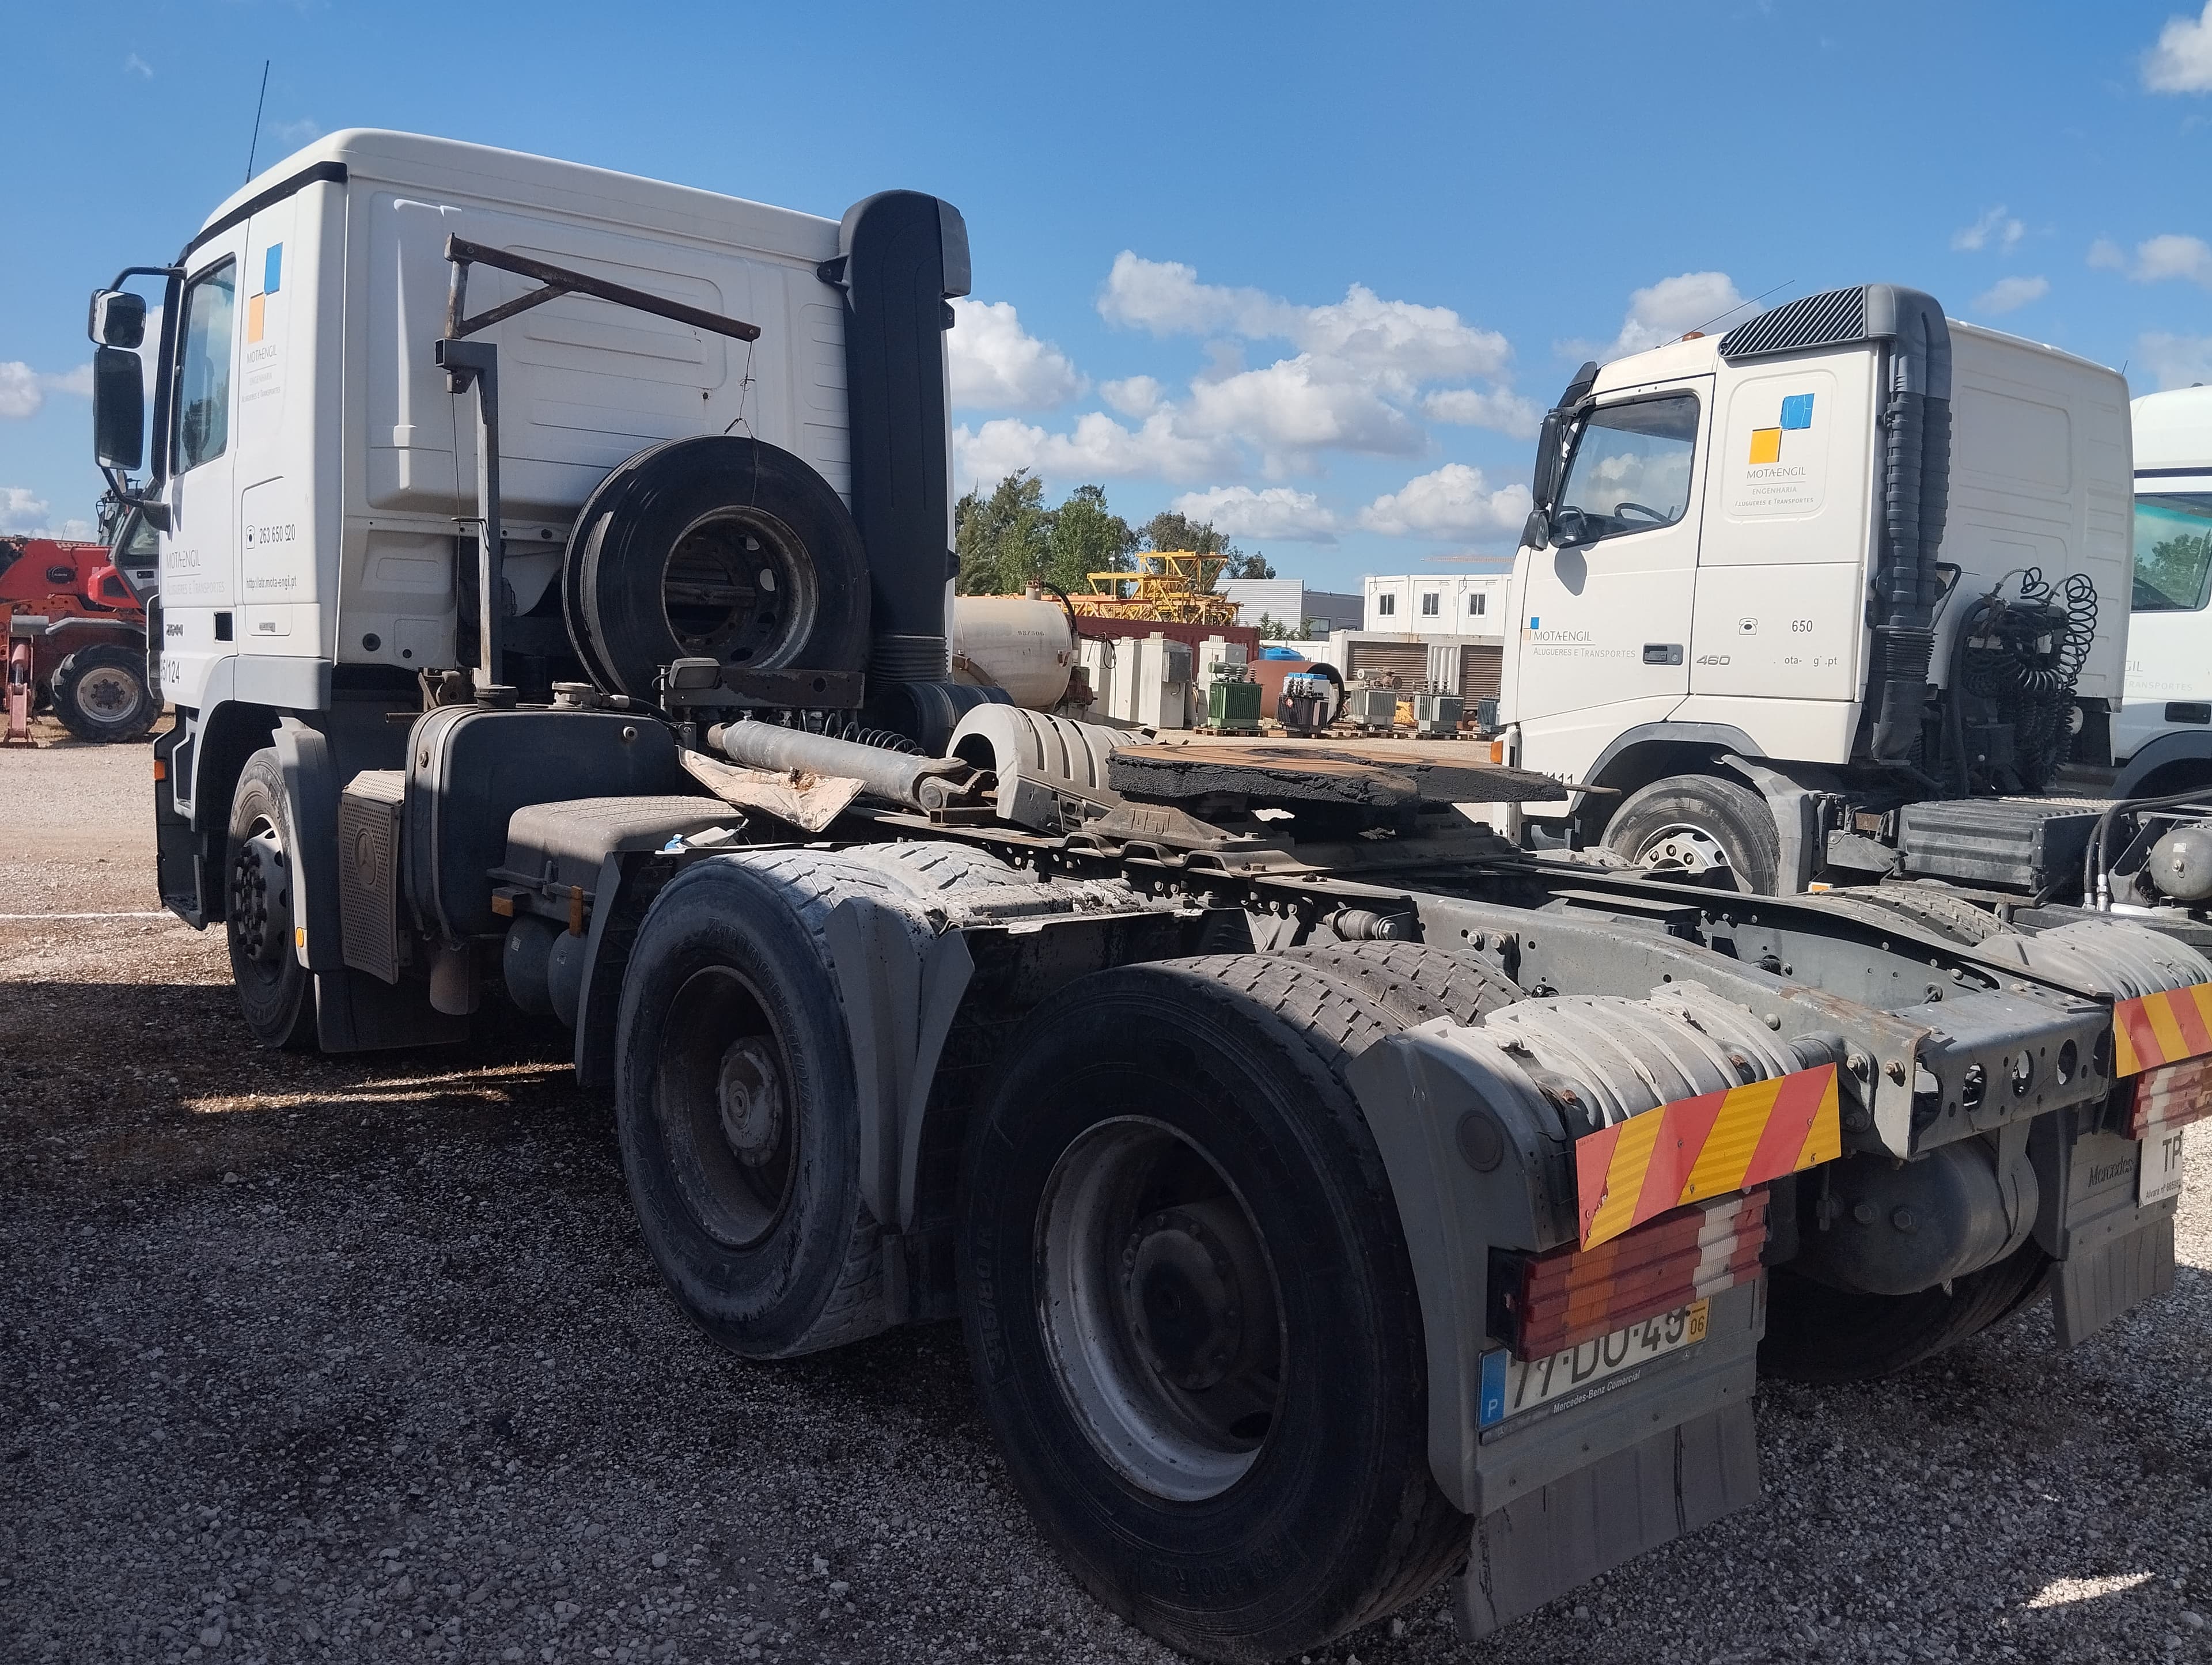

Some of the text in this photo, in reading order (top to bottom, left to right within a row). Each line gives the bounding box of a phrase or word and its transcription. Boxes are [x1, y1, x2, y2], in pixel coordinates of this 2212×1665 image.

[1752, 487, 1797, 495] ENGENHARIA
[259, 523, 296, 544] 263 650 920
[1791, 619, 1813, 633] 650
[1533, 647, 1572, 656] ALUGUERES
[1580, 648, 1636, 658] TRANSPORTES
[1696, 655, 1731, 666] 460
[1690, 1315, 1705, 1336] 06
[1552, 1370, 1641, 1414] Mercedes-Benz Comercial
[1488, 1398, 1498, 1417] P
